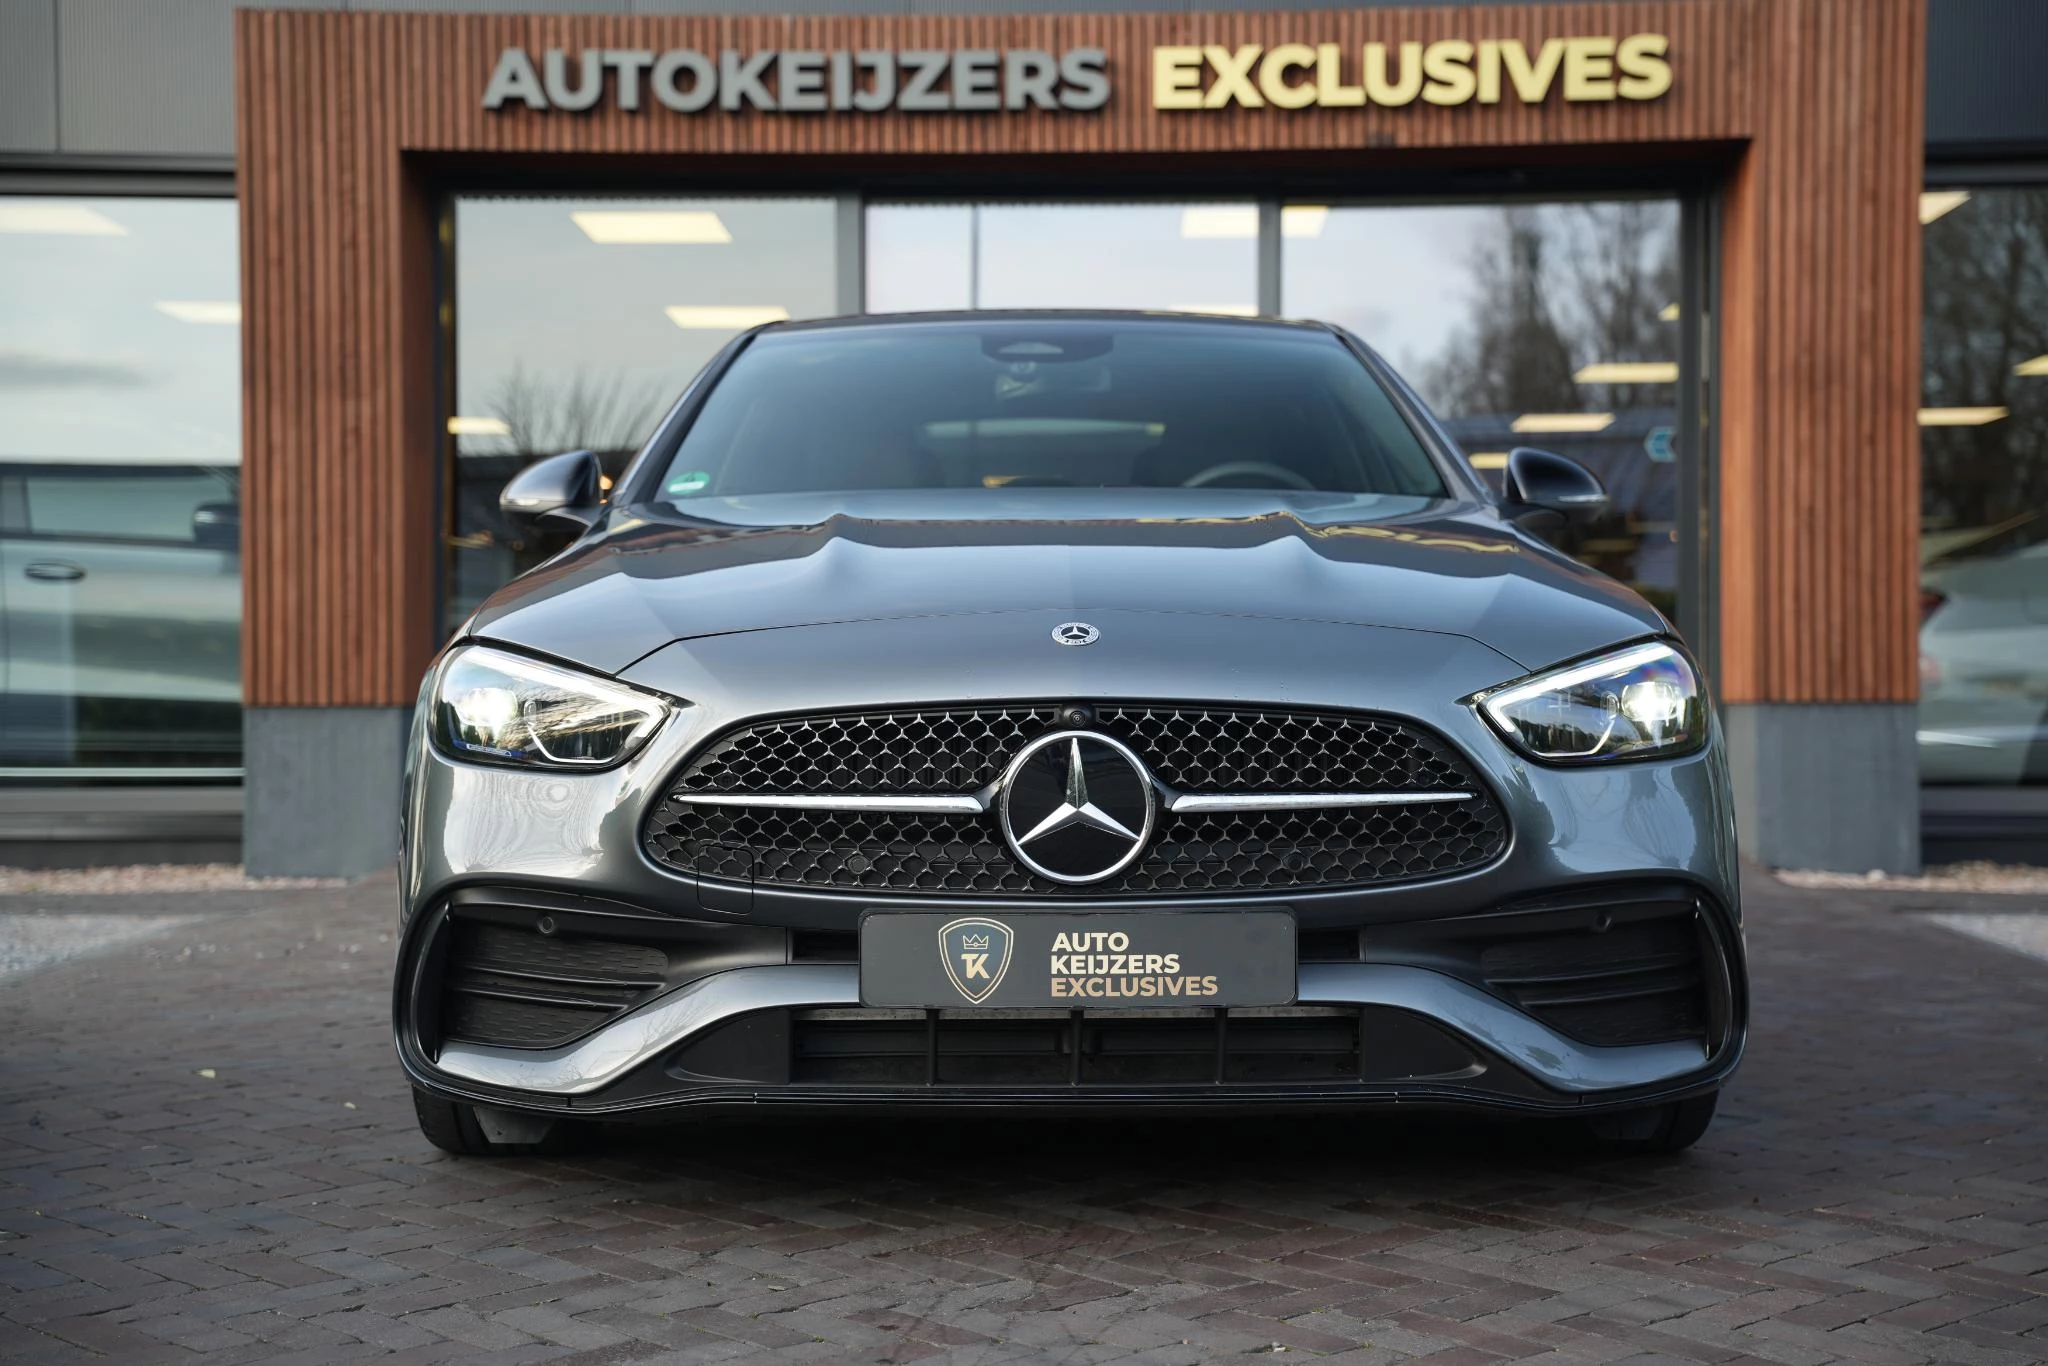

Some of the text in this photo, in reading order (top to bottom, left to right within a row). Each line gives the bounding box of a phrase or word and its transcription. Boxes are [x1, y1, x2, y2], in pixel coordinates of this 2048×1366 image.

[482, 33, 1673, 112] AUTOKEIJZERS EXCLUSIVES
[1051, 932, 1129, 952] AUTO
[1051, 953, 1181, 975] KEIJZERS
[1051, 976, 1219, 998] EXCLUSIVES
